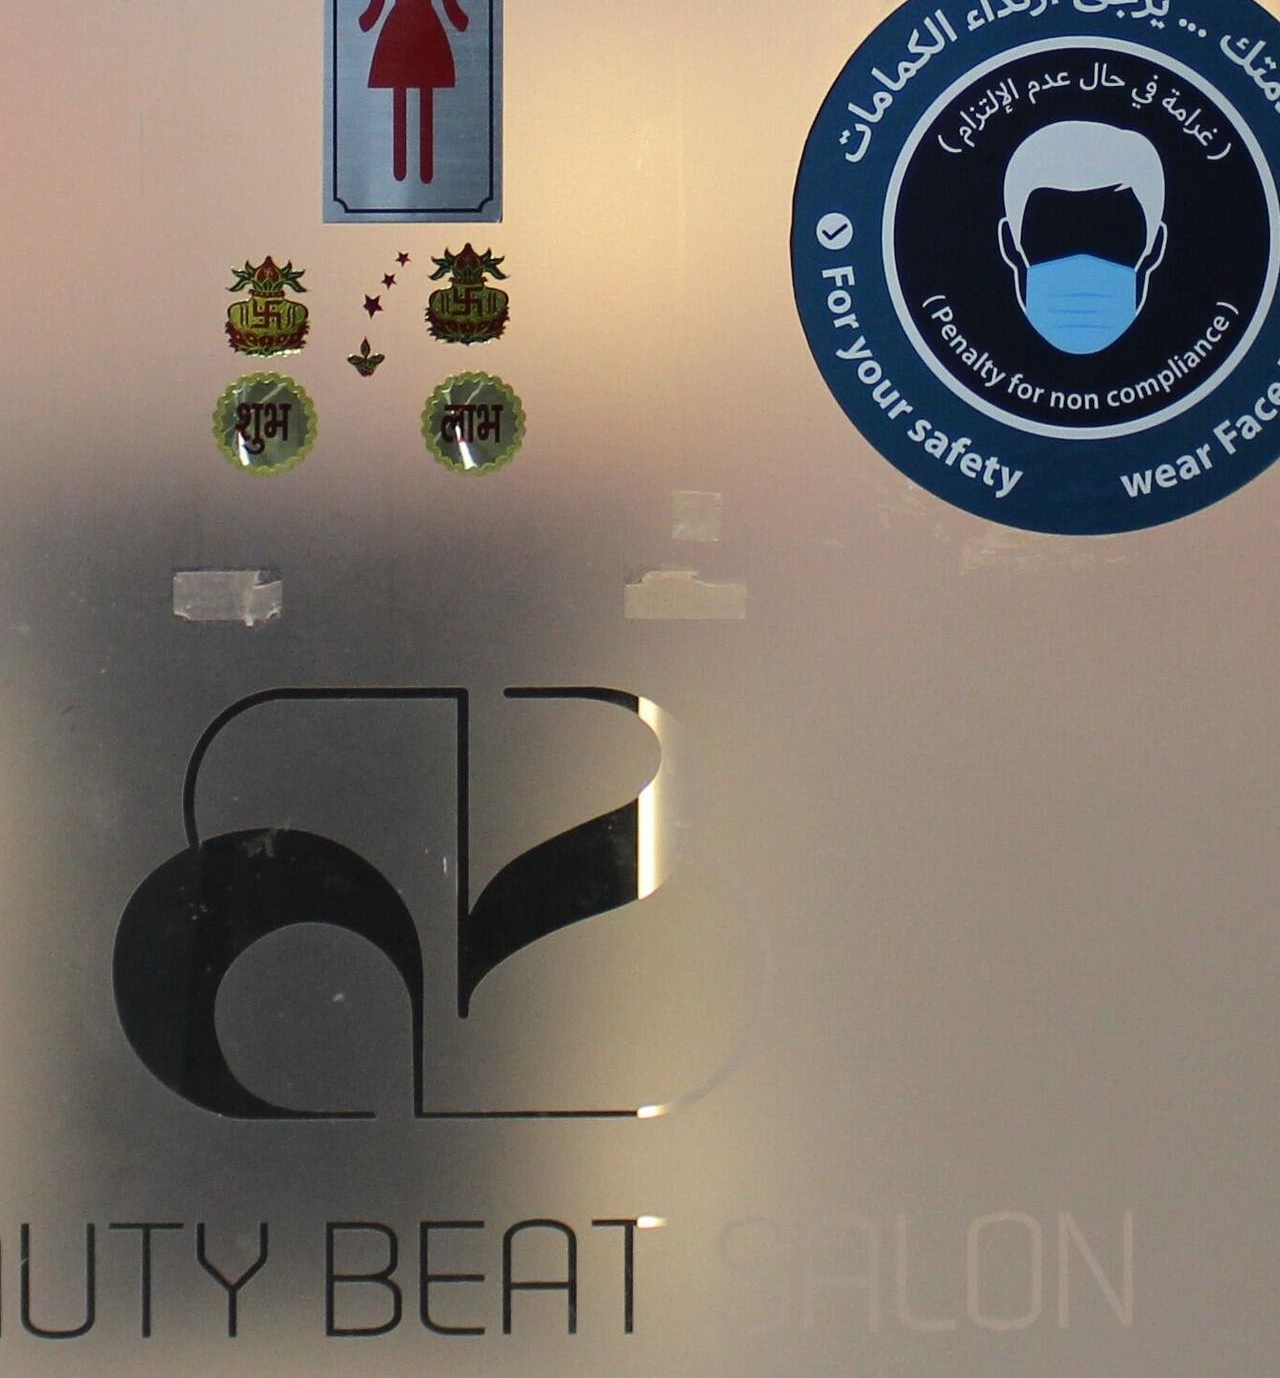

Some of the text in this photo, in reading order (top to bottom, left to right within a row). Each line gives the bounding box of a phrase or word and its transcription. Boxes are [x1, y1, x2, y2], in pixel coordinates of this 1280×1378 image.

[839, 9, 958, 163] الكمامات
[1028, 71, 1070, 104] عدم
[1079, 62, 1125, 90] حال
[1131, 74, 1157, 109] في
[821, 265, 859, 329] For
[835, 335, 914, 420] your
[1007, 374, 1044, 404] for
[1050, 392, 1099, 410] non
[236, 402, 291, 454] शुभ
[441, 403, 504, 443] लाभ
[907, 419, 1023, 498] safety
[1120, 443, 1214, 498] wear
[324, 1218, 650, 1337] BEAT
[718, 1210, 1136, 1335] SALON
